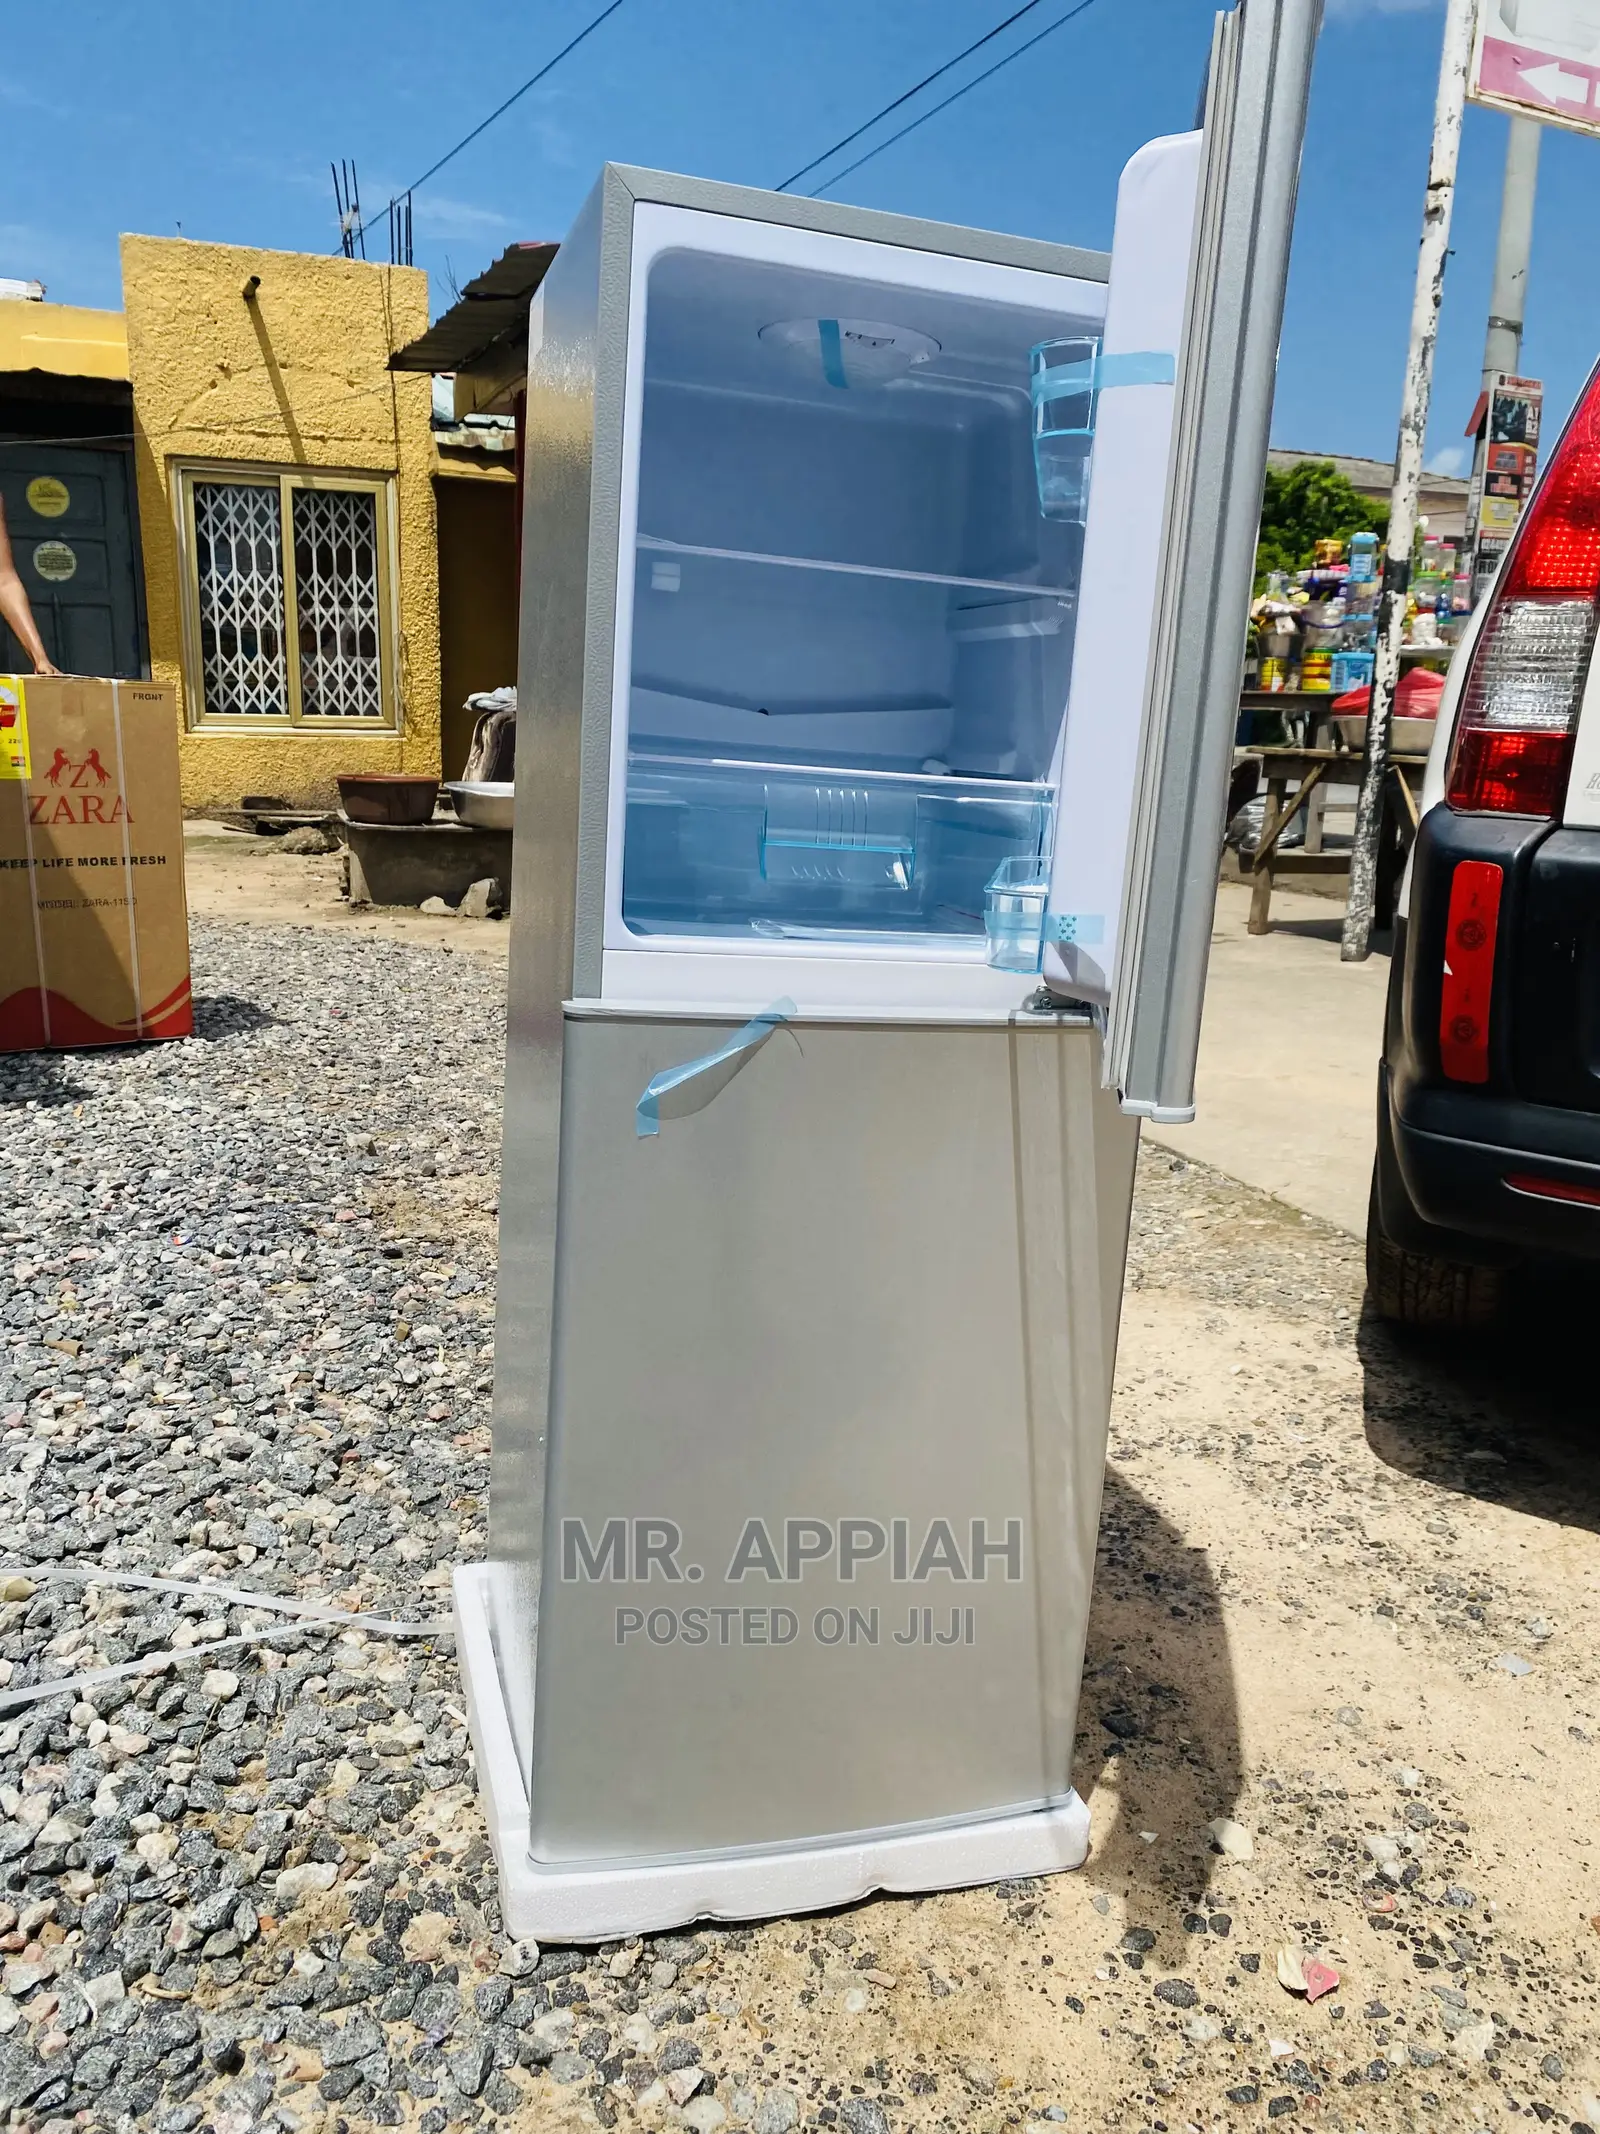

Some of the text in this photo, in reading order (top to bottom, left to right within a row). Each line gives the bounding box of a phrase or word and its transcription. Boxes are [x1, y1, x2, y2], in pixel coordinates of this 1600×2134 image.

[132, 692, 163, 701] FRONT
[28, 796, 135, 824] ZARA
[42, 858, 74, 868] LIFE
[78, 857, 118, 867] MORE
[121, 856, 166, 866] FRESH
